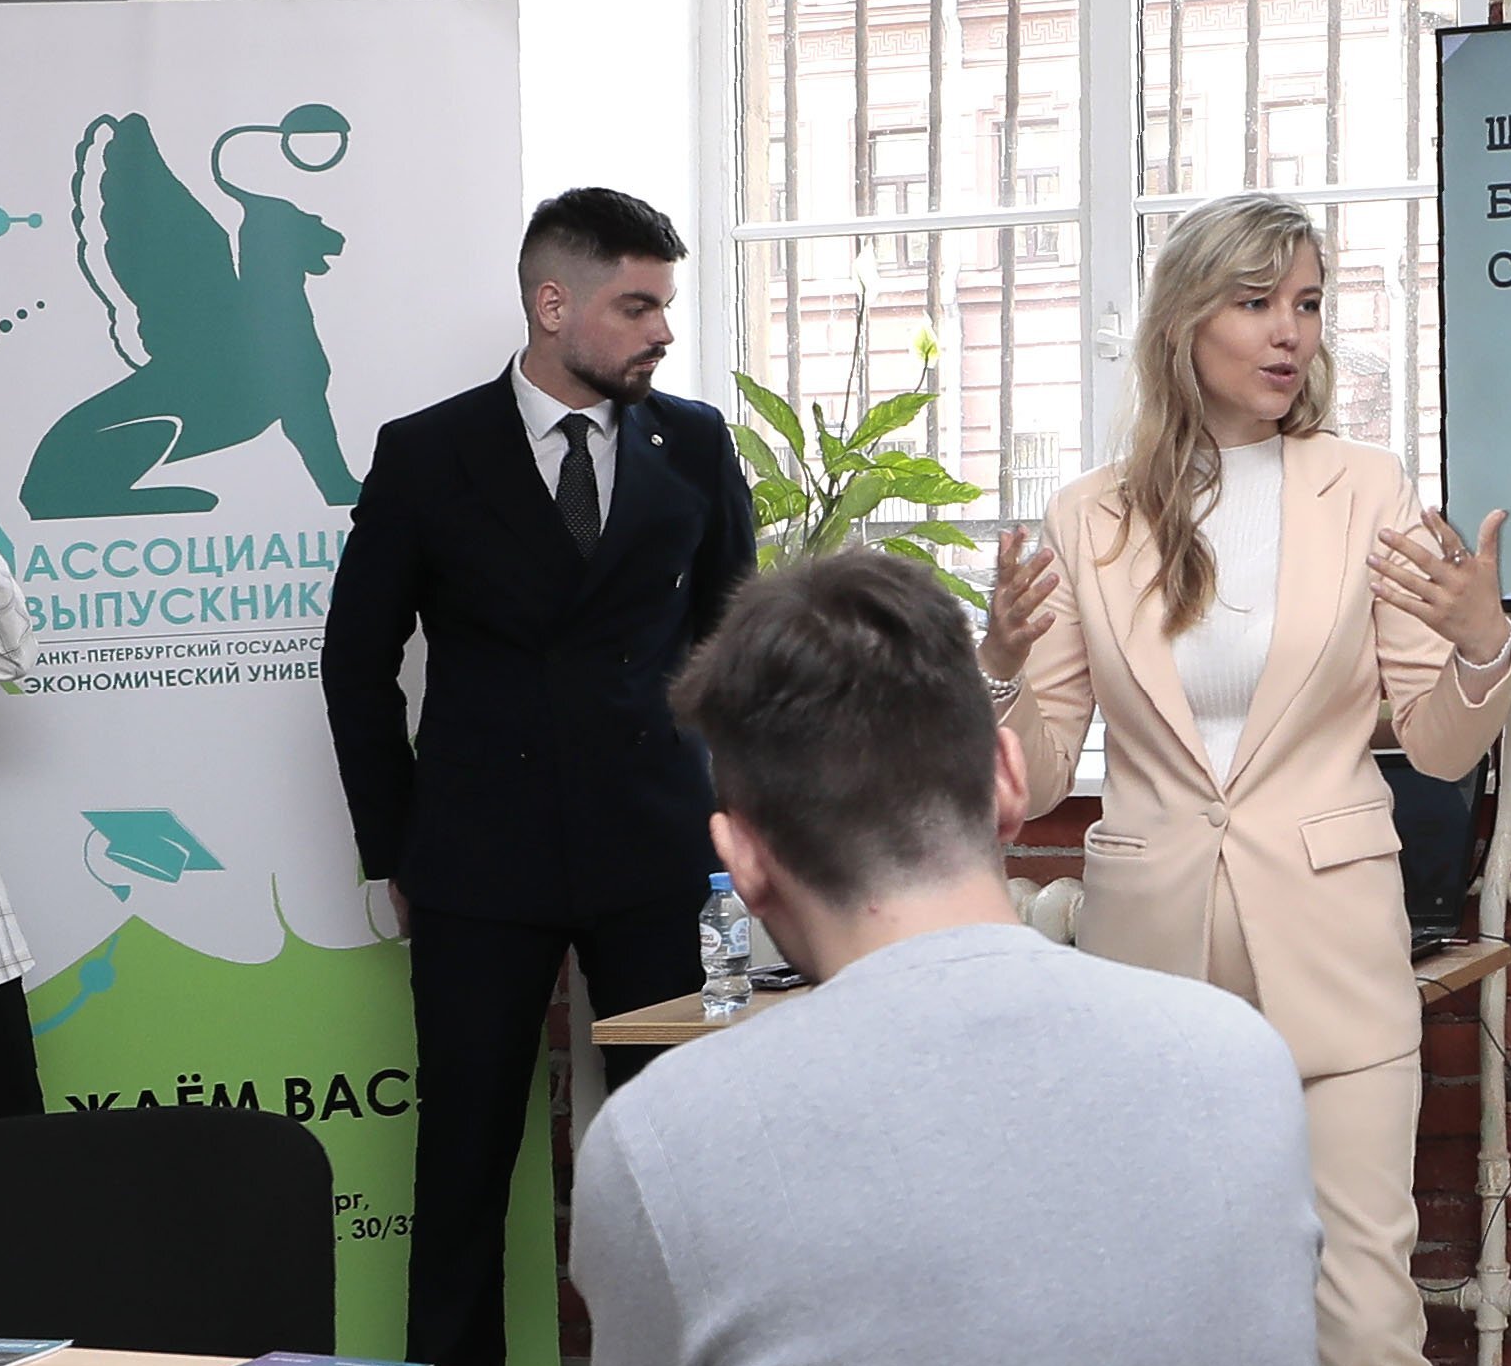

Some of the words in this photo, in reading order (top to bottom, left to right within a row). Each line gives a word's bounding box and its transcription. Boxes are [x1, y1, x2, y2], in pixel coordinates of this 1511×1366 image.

[25, 581, 334, 633] ВЫПУСКНИК
[35, 639, 221, 667] АНКТ-ПЕТЕРБУРГСКИЙ
[227, 636, 325, 657] ГОСУДАРС
[24, 662, 241, 695] ЭКОНОМИЧЕСКИЙ
[247, 660, 319, 683] УНИВЕ
